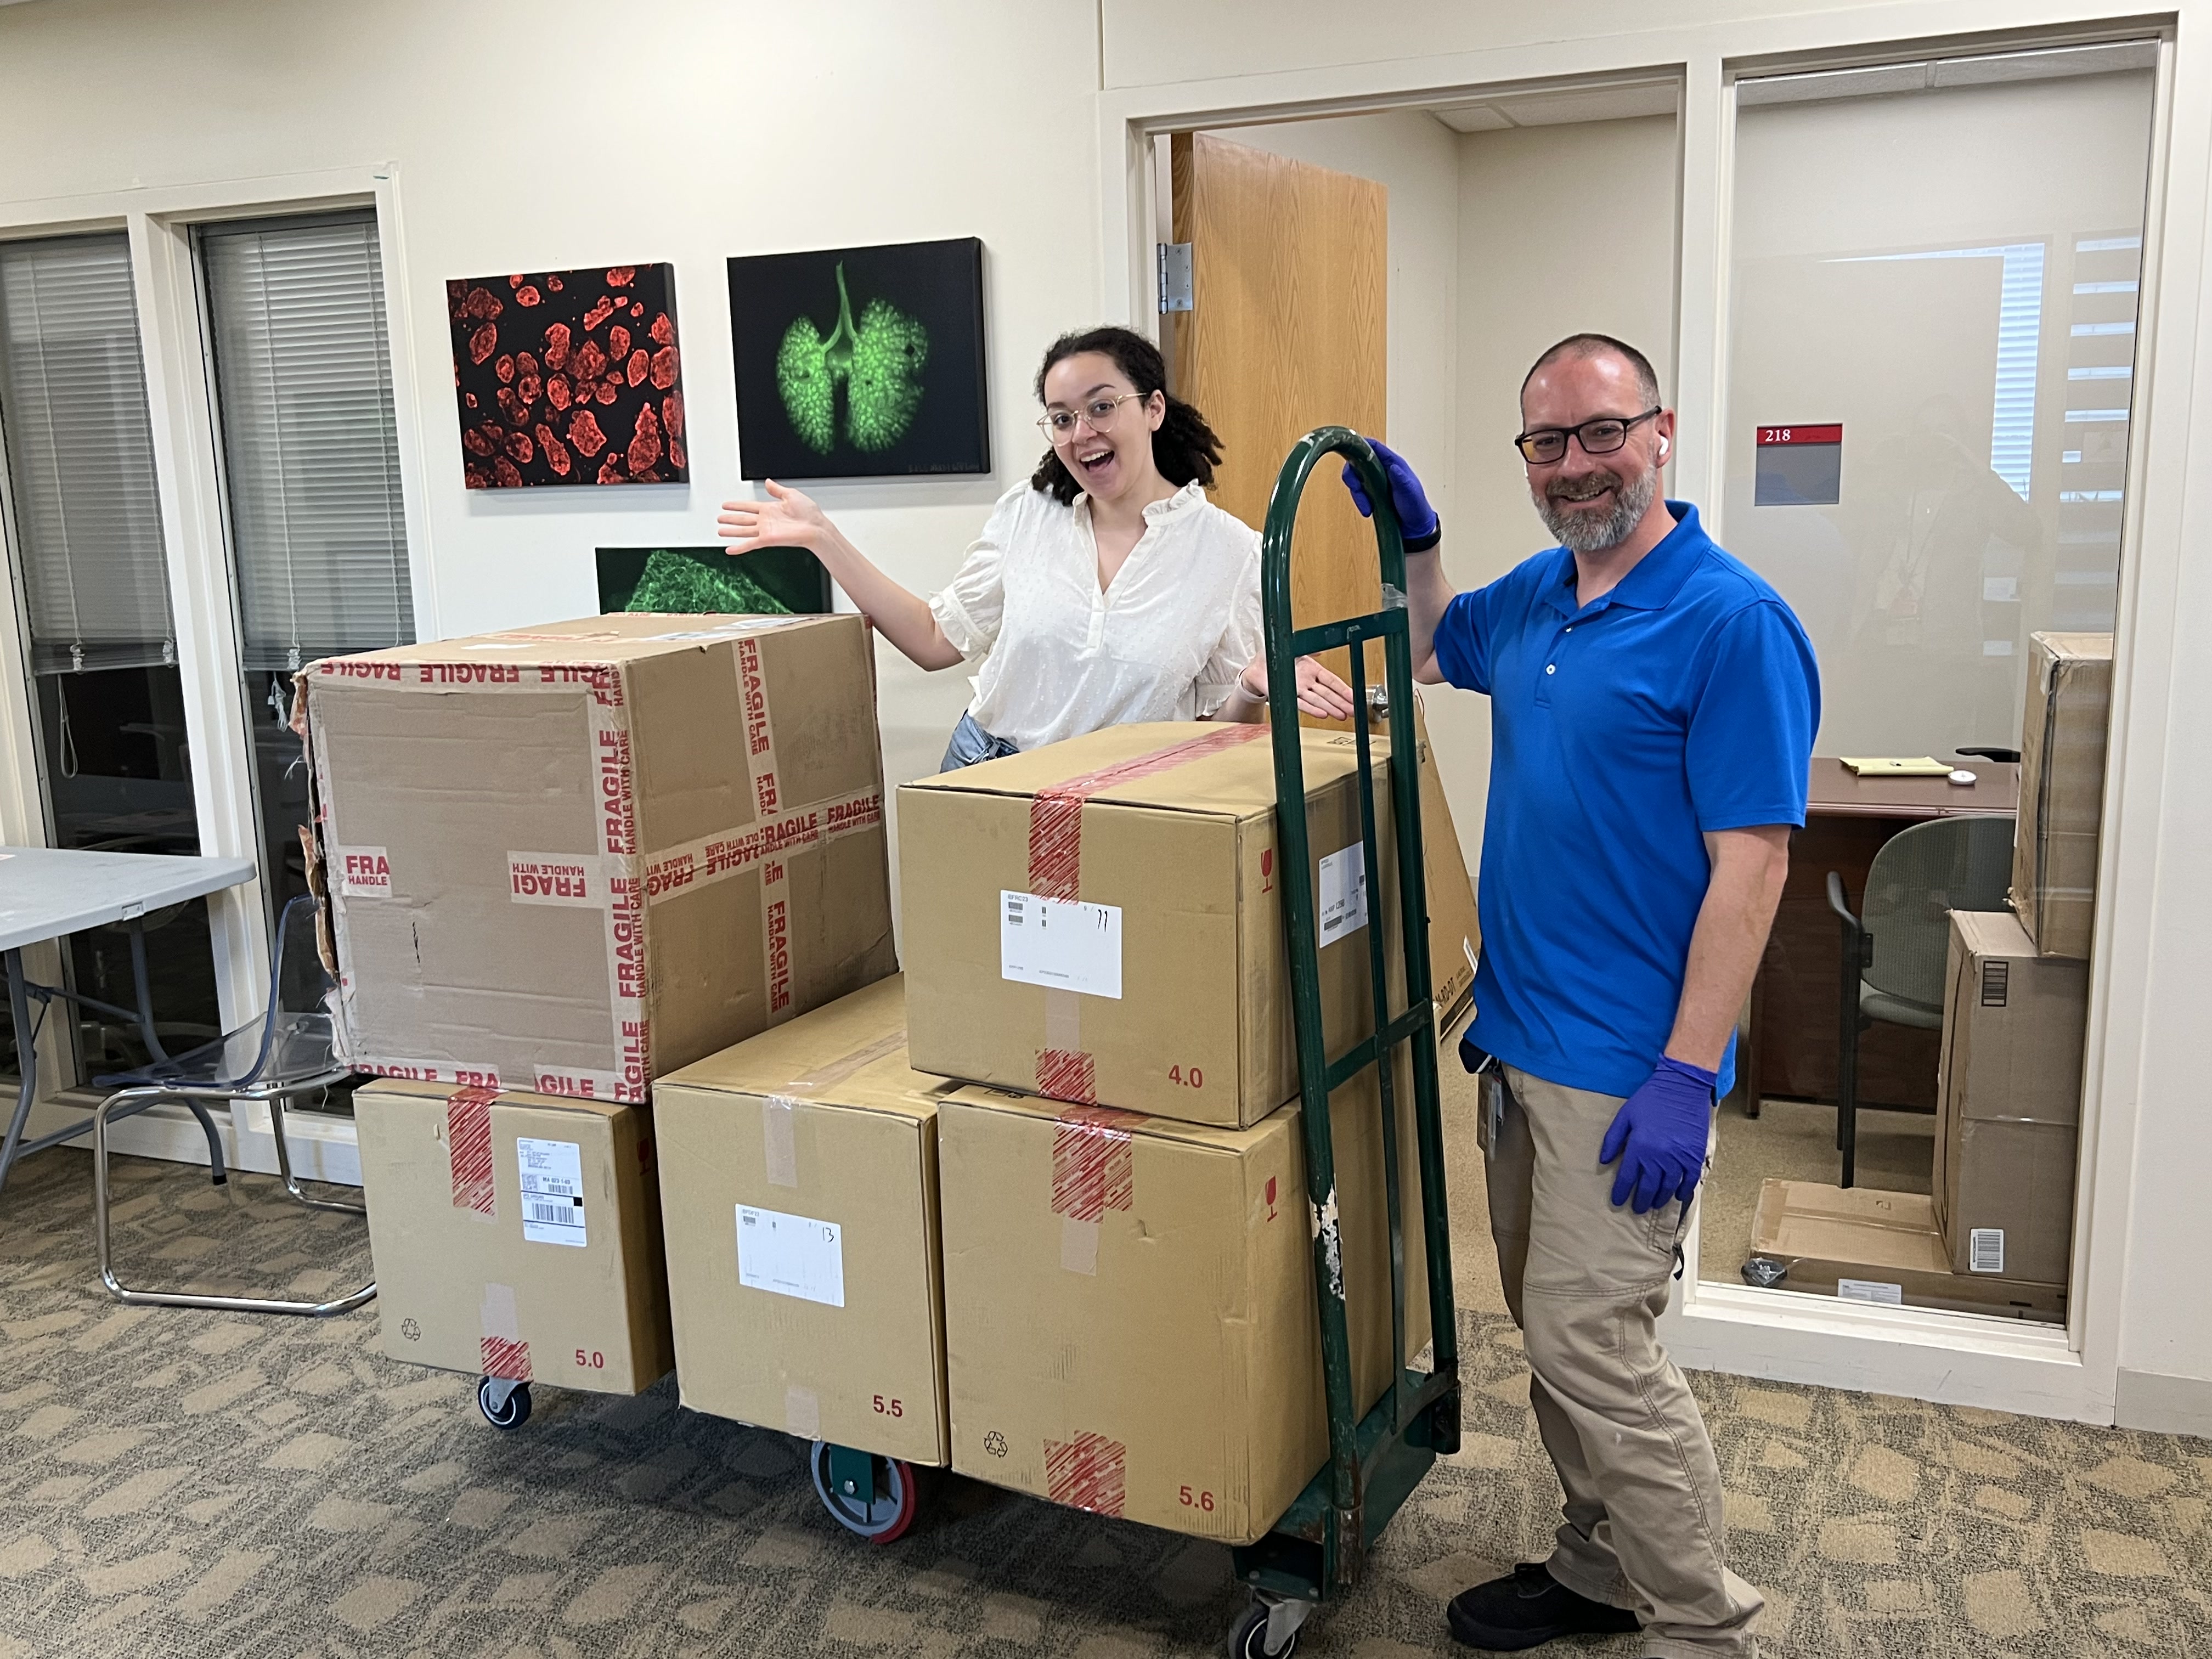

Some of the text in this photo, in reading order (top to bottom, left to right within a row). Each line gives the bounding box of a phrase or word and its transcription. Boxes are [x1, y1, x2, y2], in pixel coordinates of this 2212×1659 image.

[1765, 428, 1791, 442] 218
[419, 663, 520, 683] FRAGILE
[738, 641, 760, 755] HANDLE WITH CARE
[744, 639, 770, 753] FRAGILE
[599, 730, 624, 855] FRAGILE
[617, 730, 636, 855] HANDLE WITH CARE
[827, 794, 881, 824] FRAGILE
[704, 840, 725, 858] CARE
[726, 836, 744, 850] WITH
[346, 855, 390, 874] FRA
[512, 862, 584, 877] HANDLE WITH
[663, 853, 693, 872] HANDLE
[348, 876, 388, 886] HANDLE
[513, 874, 586, 898] FRAGI
[611, 878, 636, 998] FRAGILE
[628, 877, 646, 998] HANDLE WITH CARE
[768, 905, 776, 950] HANDLE
[774, 899, 789, 1010] FRAGILE
[1168, 1064, 1203, 1088] 4.0
[822, 1227, 834, 1243] 13
[575, 1349, 604, 1369] 5.0
[873, 1394, 903, 1418] 5.5
[1179, 1485, 1215, 1511] 5.6
